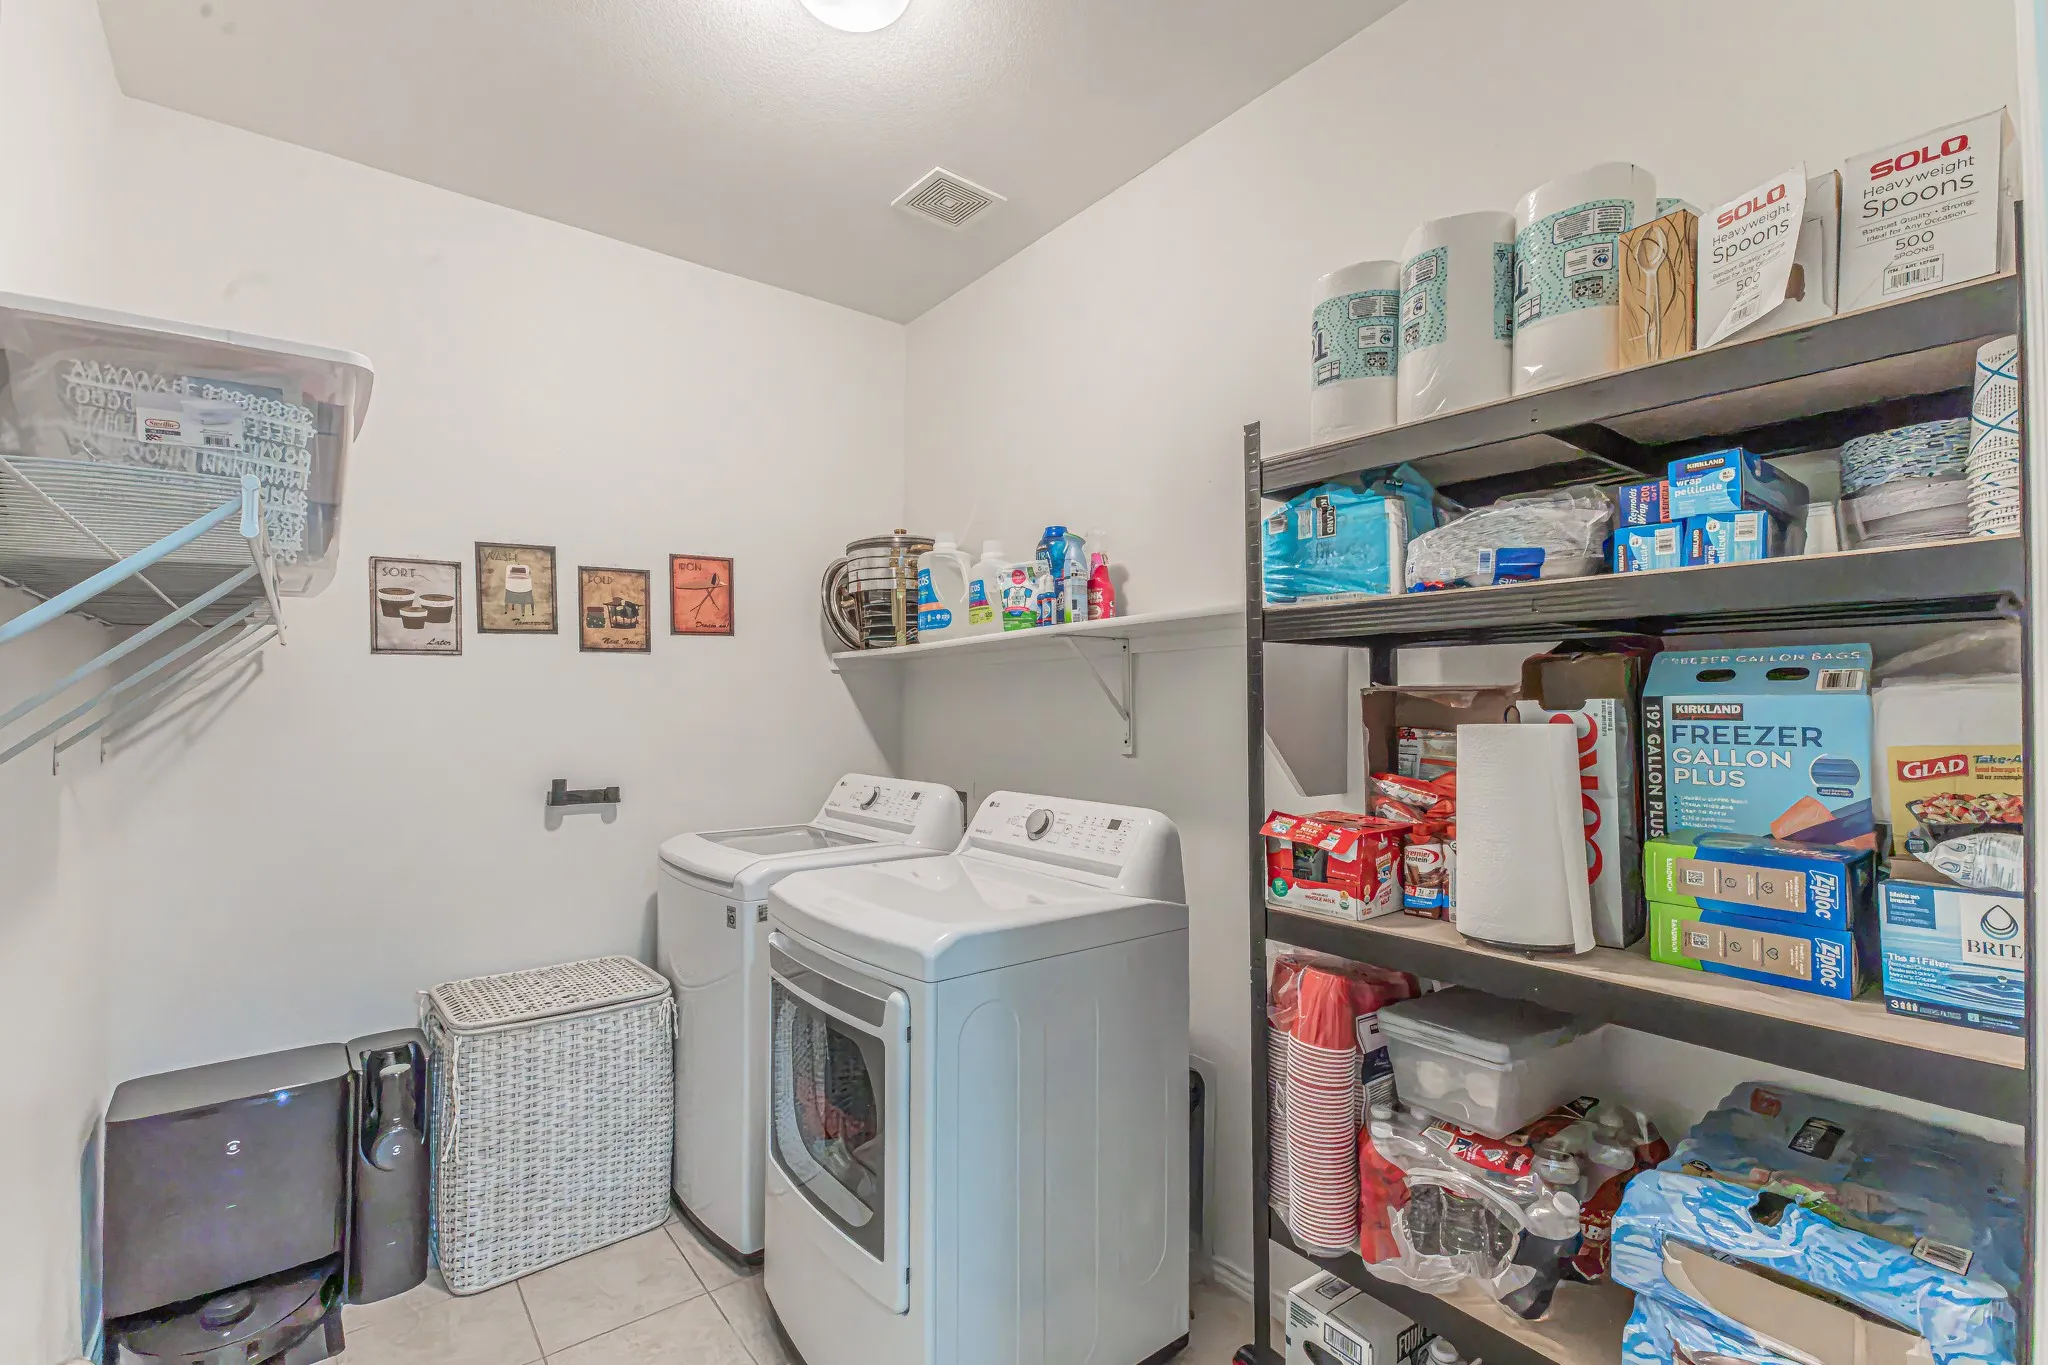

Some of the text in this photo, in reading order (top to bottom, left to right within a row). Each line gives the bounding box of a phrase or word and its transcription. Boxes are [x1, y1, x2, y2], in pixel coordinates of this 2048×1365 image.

[1869, 134, 1970, 181] SOLO
[1863, 155, 1975, 199] Heavyweight
[1716, 183, 1786, 230] SOLO
[1862, 174, 1975, 219] Spoons
[1712, 202, 1791, 246] Heavyweight
[1889, 226, 1902, 236] for
[1904, 221, 1922, 231] Any
[1924, 209, 1967, 225] Occasion
[1900, 211, 1932, 225] Quality
[1712, 218, 1790, 264] Spoons
[1895, 230, 1935, 251] 500
[1893, 244, 1935, 261] SPOONS
[1736, 271, 1761, 292] 500
[1675, 477, 1702, 488] wrap
[1628, 488, 1638, 524] Reynolds
[382, 566, 417, 578] SORT
[678, 562, 702, 572] IRON
[427, 637, 451, 647] Later
[1735, 653, 1806, 663] GALLON
[1811, 651, 1861, 661] BAGS
[1675, 704, 1741, 714] KIRKLAND
[1671, 724, 1823, 748] FREEZER
[1672, 747, 1792, 769] GALLON
[1646, 705, 1665, 838] 192 GALLON PLUS
[1674, 767, 1747, 788] PLUS
[1902, 759, 1965, 779] GLAD
[1809, 874, 1839, 920] Ziploc
[1967, 939, 2025, 959] BRIT
[1812, 942, 1843, 989] Ziploc
[1921, 957, 1950, 968] Filter
[1891, 1000, 1899, 1008] 3
